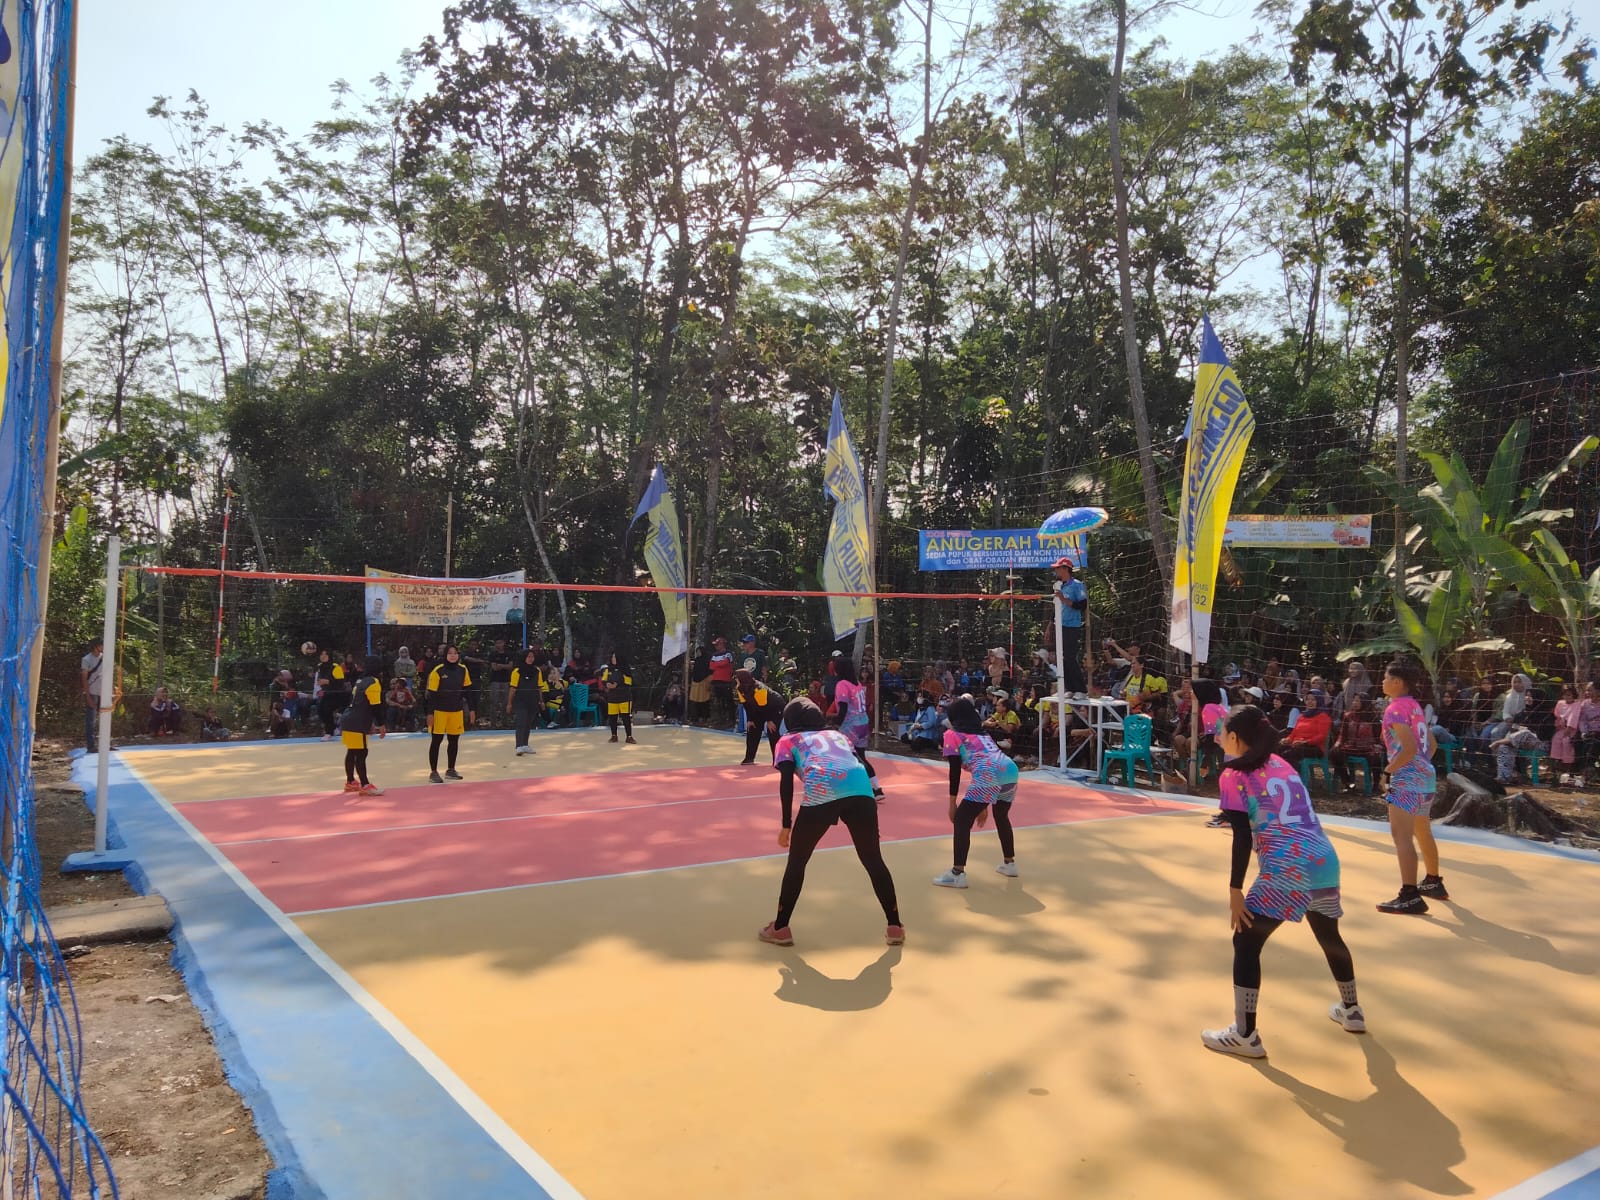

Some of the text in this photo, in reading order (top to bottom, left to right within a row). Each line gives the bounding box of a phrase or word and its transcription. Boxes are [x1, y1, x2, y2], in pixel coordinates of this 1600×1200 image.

[1306, 514, 1345, 522] MOTOR
[926, 534, 1080, 551] ANUGERAH TANI
[926, 551, 946, 559] SEDIA
[973, 549, 1012, 557] BERSUBSIDI
[1014, 549, 1032, 557] DAN
[1033, 549, 1052, 557] NON
[962, 556, 1016, 564] OBAT-OBATAN
[1018, 556, 1059, 564] PERTANIAN
[390, 585, 522, 595] SELAMAT BERTANDING
